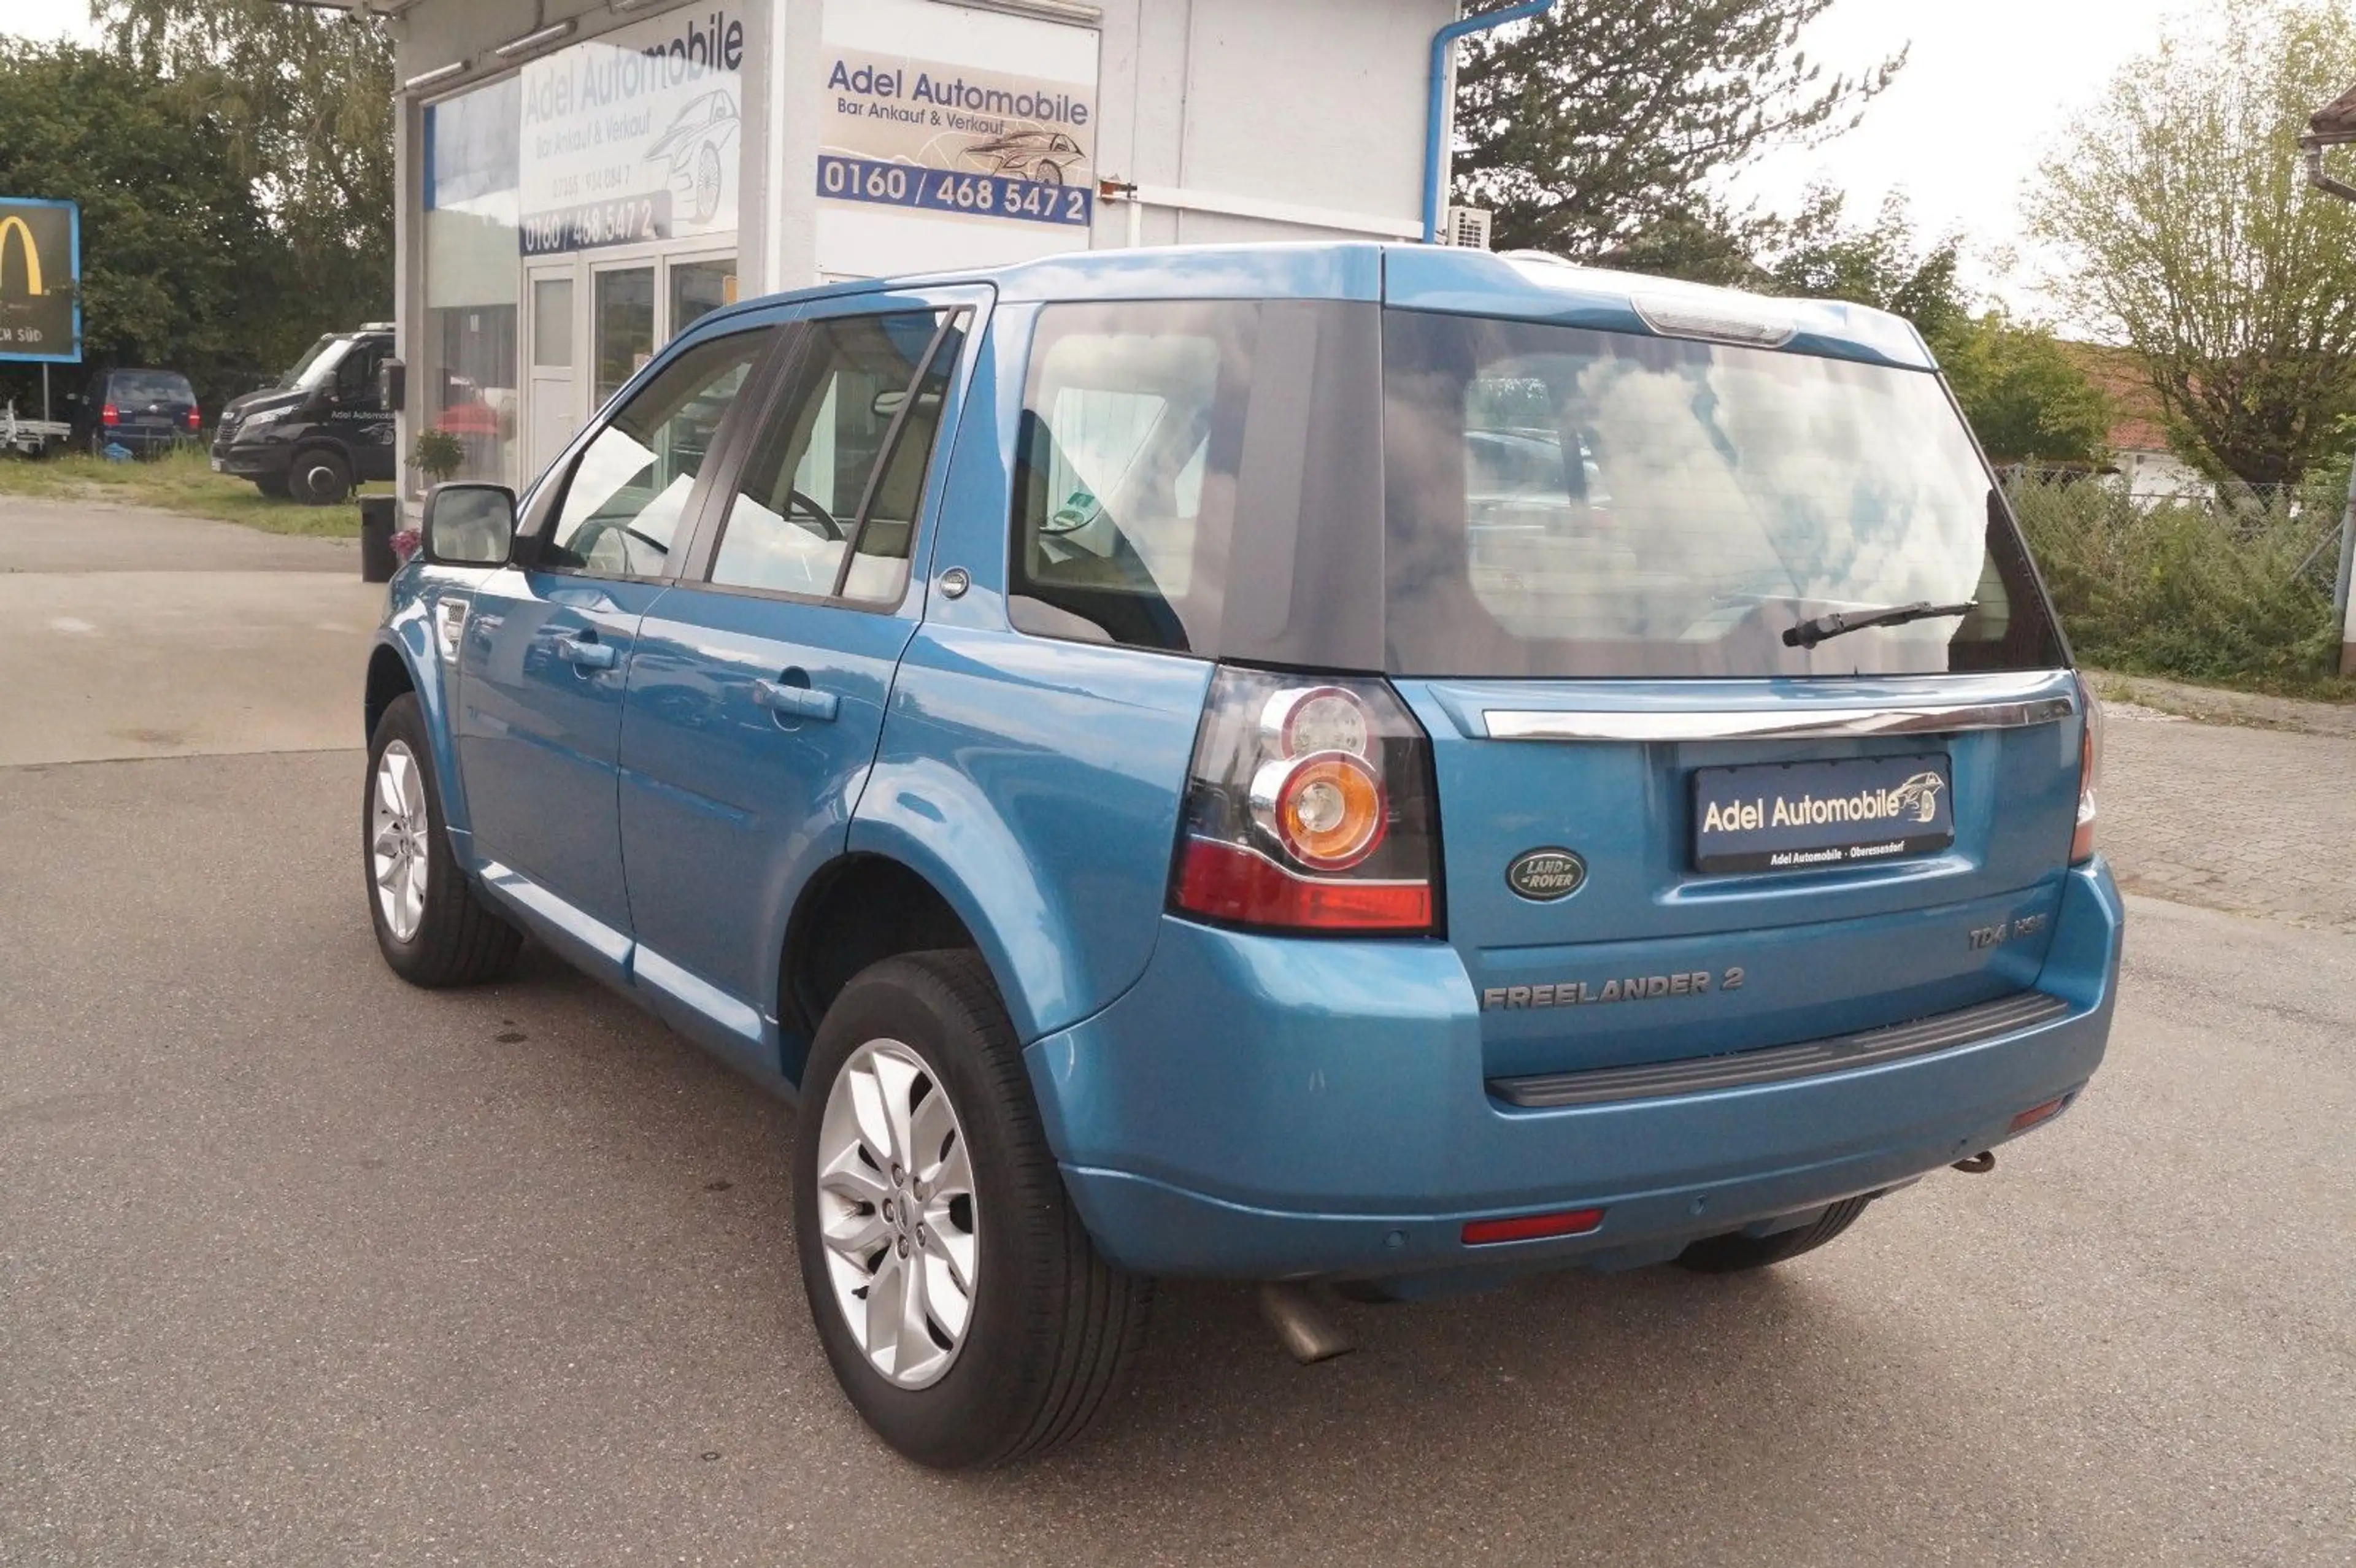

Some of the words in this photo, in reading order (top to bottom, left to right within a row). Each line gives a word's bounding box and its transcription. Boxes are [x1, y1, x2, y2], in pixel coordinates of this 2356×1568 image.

[525, 59, 574, 126] Adel
[581, 10, 743, 111] Automobile
[828, 60, 902, 98] Adel
[912, 73, 1088, 126] Automobile
[606, 109, 652, 142] Verkauf
[837, 98, 863, 116] Bar
[868, 102, 925, 124] Ankauf
[930, 111, 942, 126] &
[947, 112, 1004, 135] Verkauf
[825, 161, 907, 199] 0160
[915, 172, 927, 204] /
[936, 176, 994, 210] 468
[1004, 183, 1059, 216] 547
[1066, 190, 1084, 220] 2
[525, 213, 560, 251] 0160
[573, 206, 600, 245] 468
[606, 202, 635, 240] 547
[641, 199, 653, 237] 2
[17, 326, 43, 342] SÜD
[1703, 798, 1763, 832] Adel
[1771, 789, 1900, 827] Automobile
[1526, 861, 1564, 874] LAND
[1771, 852, 1792, 865] Adel
[1793, 848, 1842, 864] Automobile
[1850, 840, 1905, 858] Oberessendorf
[1528, 874, 1574, 887] ROVER
[1481, 971, 1711, 1011] FREELANDER
[1720, 967, 1744, 991] 2
